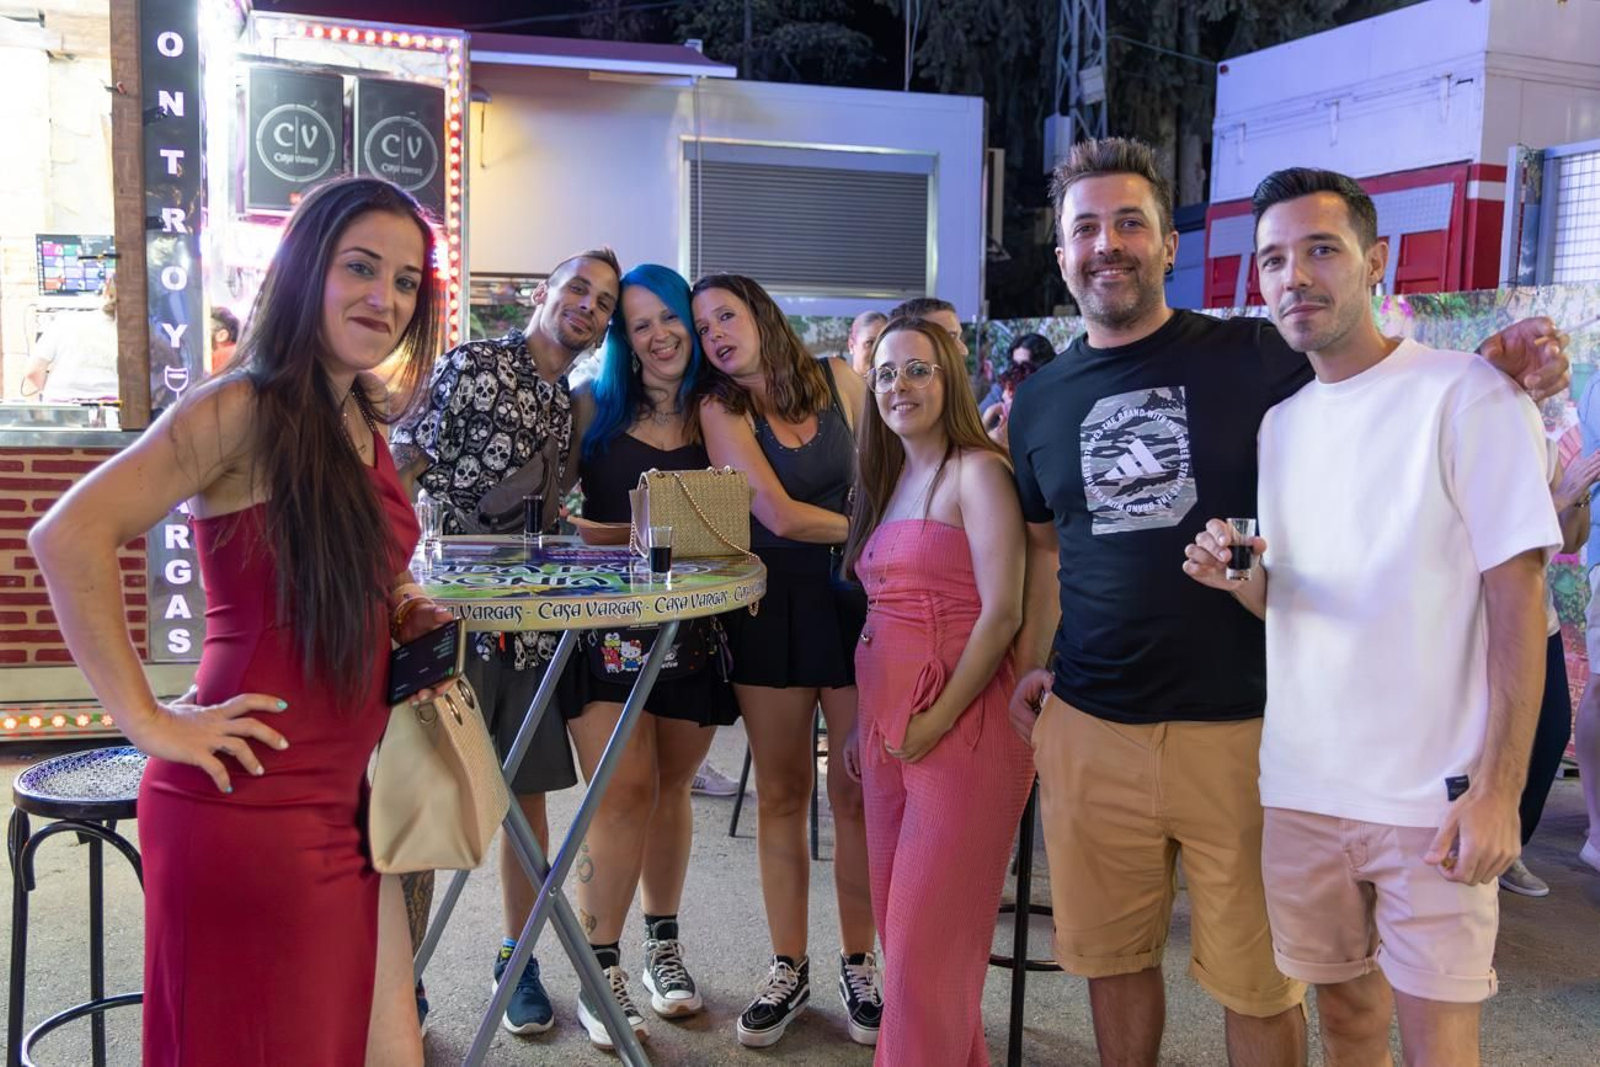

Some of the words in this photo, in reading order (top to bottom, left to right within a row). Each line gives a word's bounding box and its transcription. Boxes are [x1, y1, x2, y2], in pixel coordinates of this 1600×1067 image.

[1101, 416, 1116, 430] THE
[1117, 408, 1146, 421] BRAND
[1146, 410, 1168, 424] WITH
[1165, 419, 1181, 435] THE
[1175, 433, 1190, 460] THREE
[459, 603, 523, 626] VARGAS
[538, 602, 581, 623] CASA
[585, 600, 644, 623] VARGAS
[654, 596, 688, 614] CASA
[690, 590, 728, 609] VARGAS
